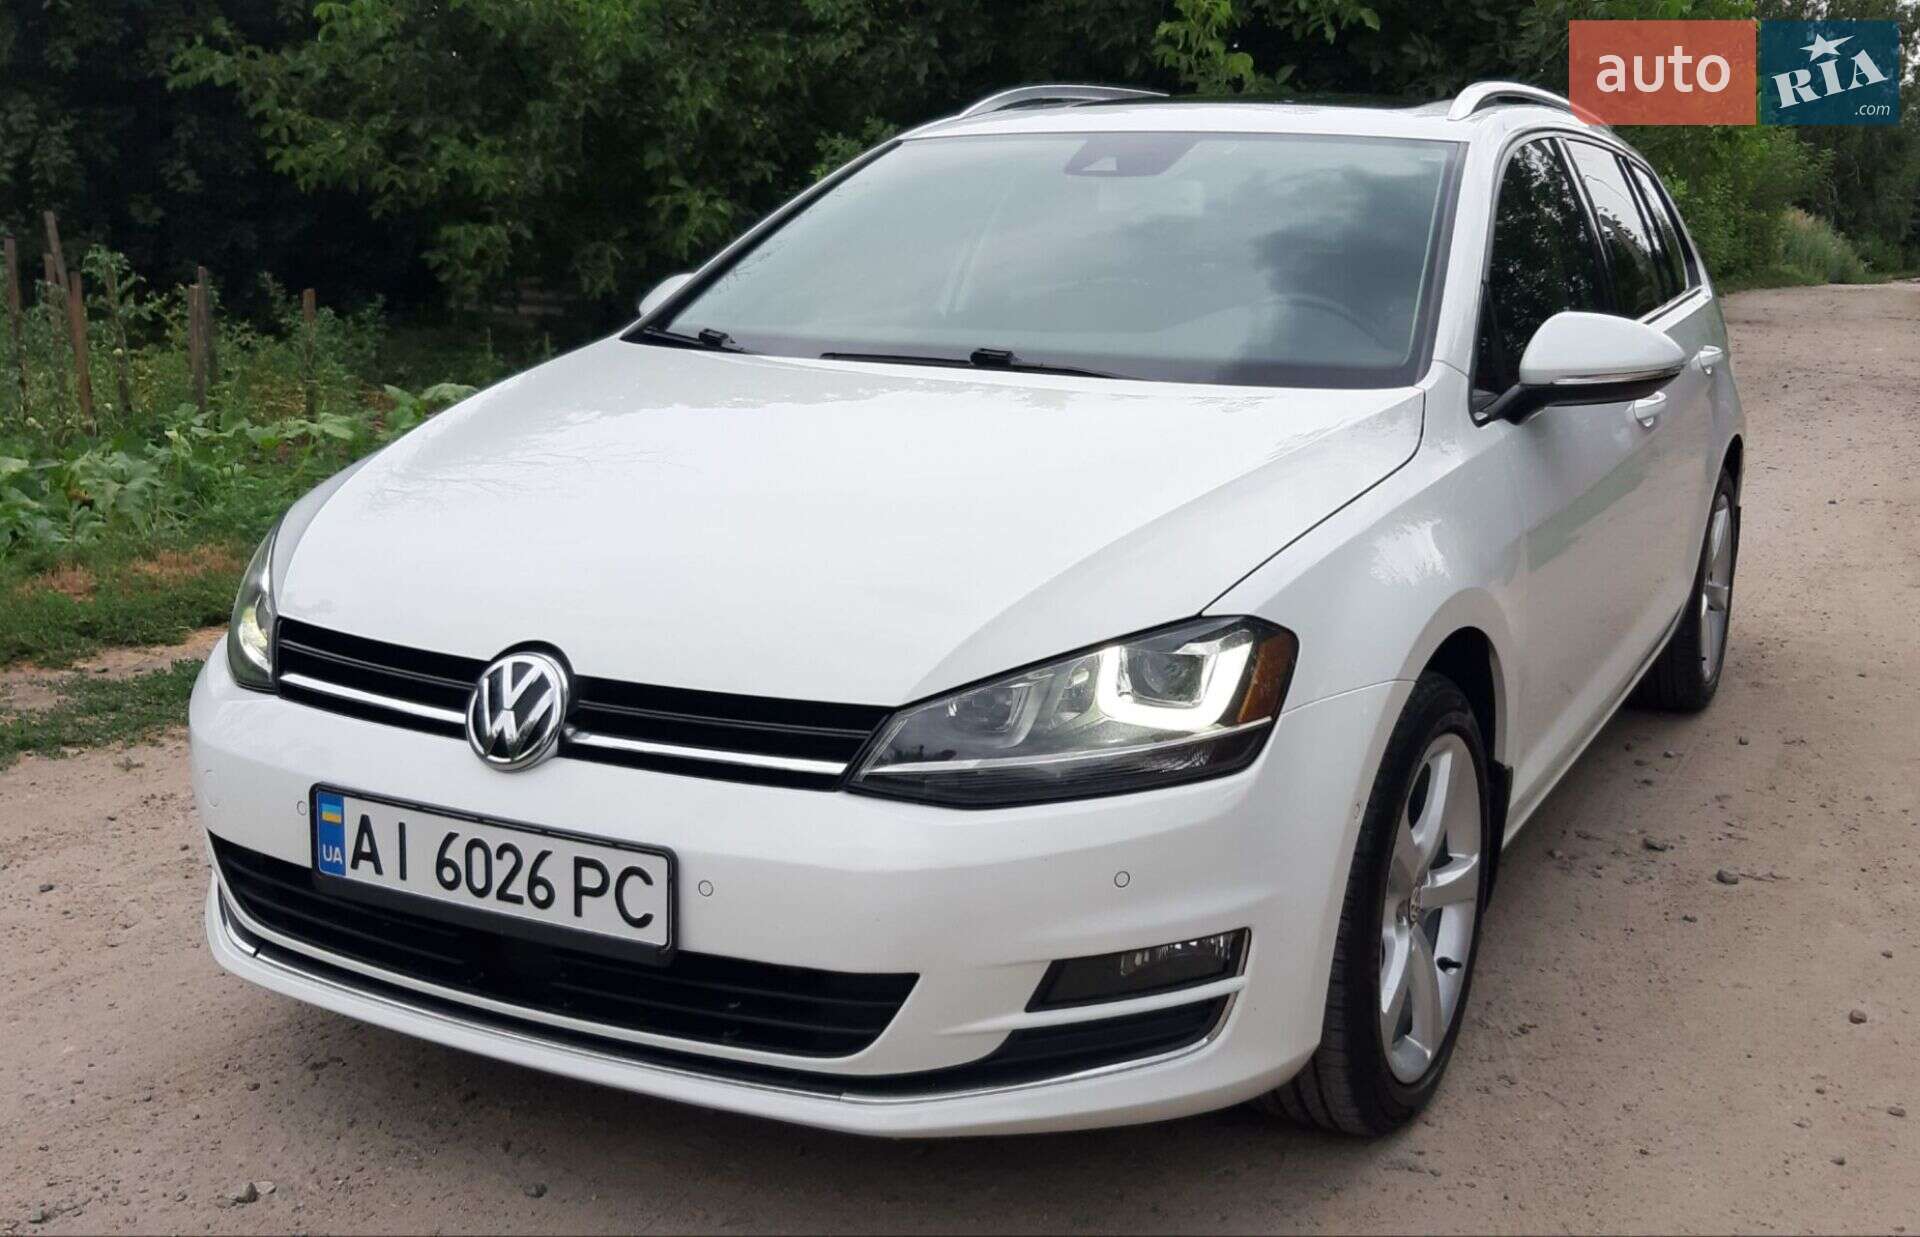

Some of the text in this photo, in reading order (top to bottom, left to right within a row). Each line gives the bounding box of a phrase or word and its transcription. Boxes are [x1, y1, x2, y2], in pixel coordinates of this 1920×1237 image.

[322, 844, 343, 865] UA
[350, 813, 654, 929] AI 6026 PC
